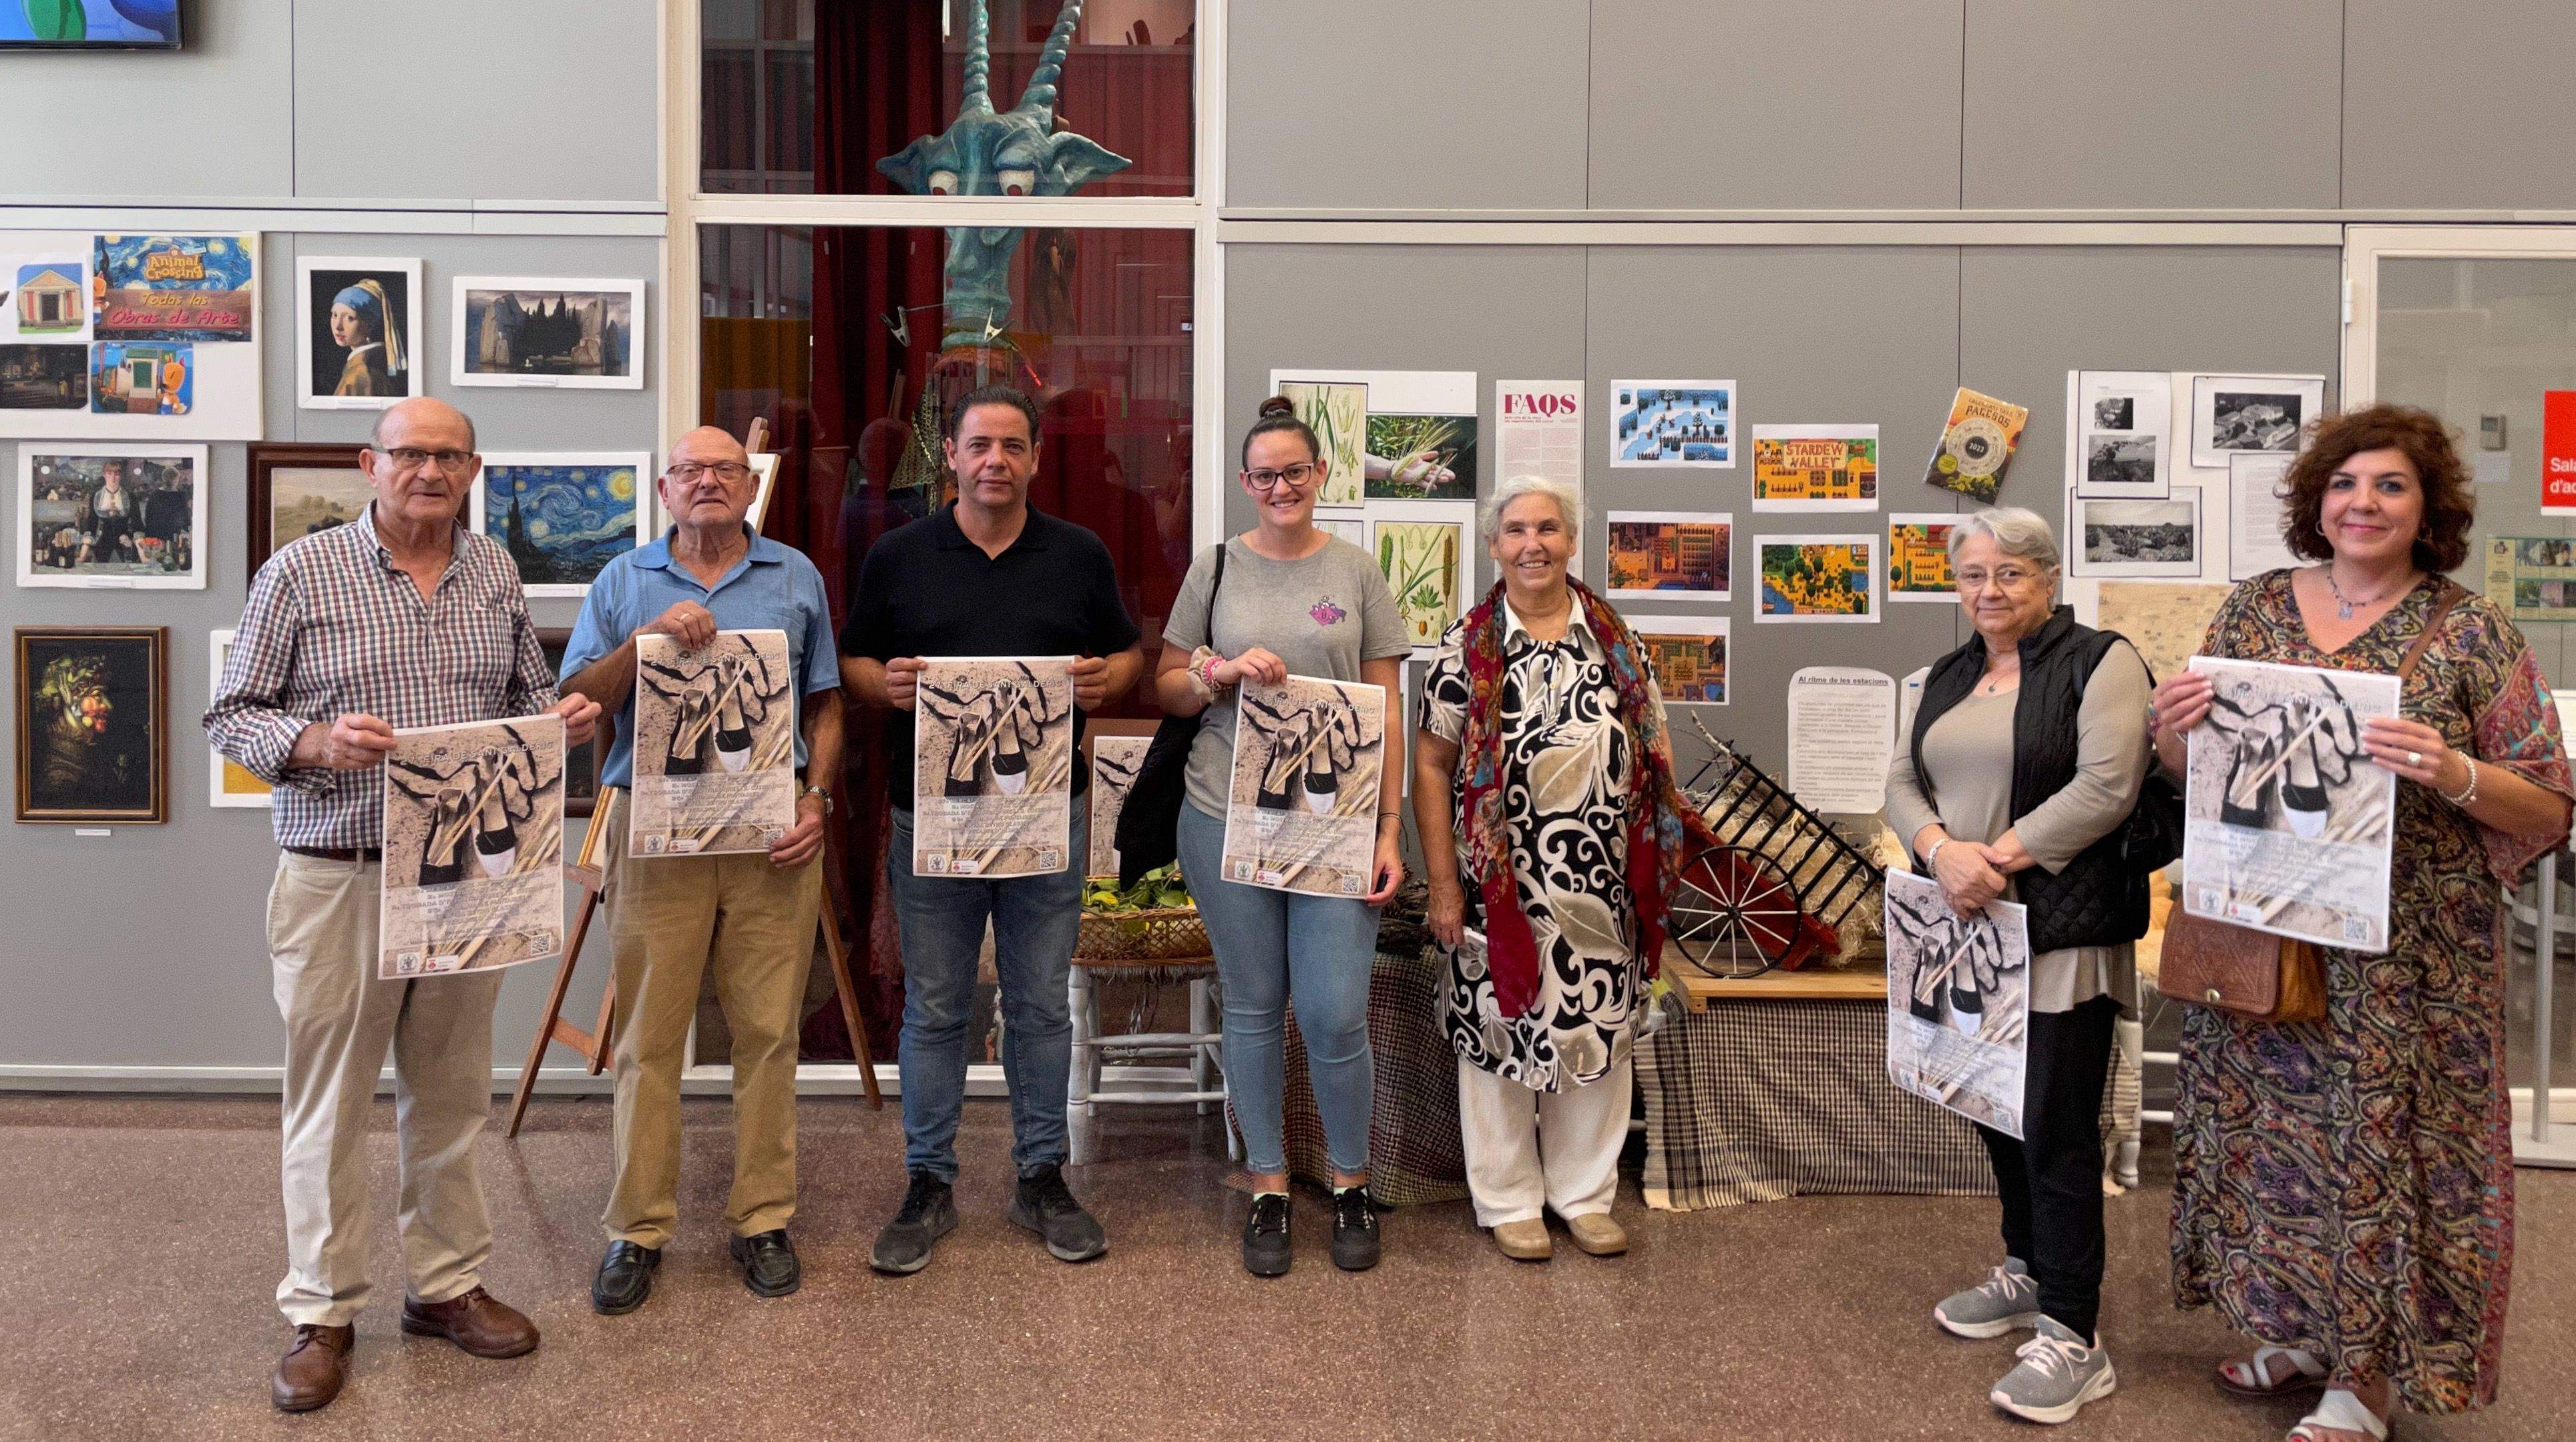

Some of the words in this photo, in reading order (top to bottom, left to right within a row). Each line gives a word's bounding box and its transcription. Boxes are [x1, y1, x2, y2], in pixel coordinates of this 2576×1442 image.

[150, 254, 200, 268] Animal
[146, 264, 204, 280] Crossing
[142, 293, 182, 306] Todas
[189, 293, 209, 306] las
[110, 309, 161, 325] Obras
[166, 308, 190, 325] de
[198, 310, 240, 325] Arte
[1504, 393, 1576, 417] FAQS
[1965, 405, 2011, 428] PAGESOS
[1786, 443, 1844, 456] STARDEW
[1790, 457, 1837, 468] VALLEY
[2551, 458, 2576, 472] Sal
[712, 654, 734, 663] SANT
[988, 681, 1010, 689] SANT
[453, 751, 467, 761] DE
[470, 748, 497, 759] SANT
